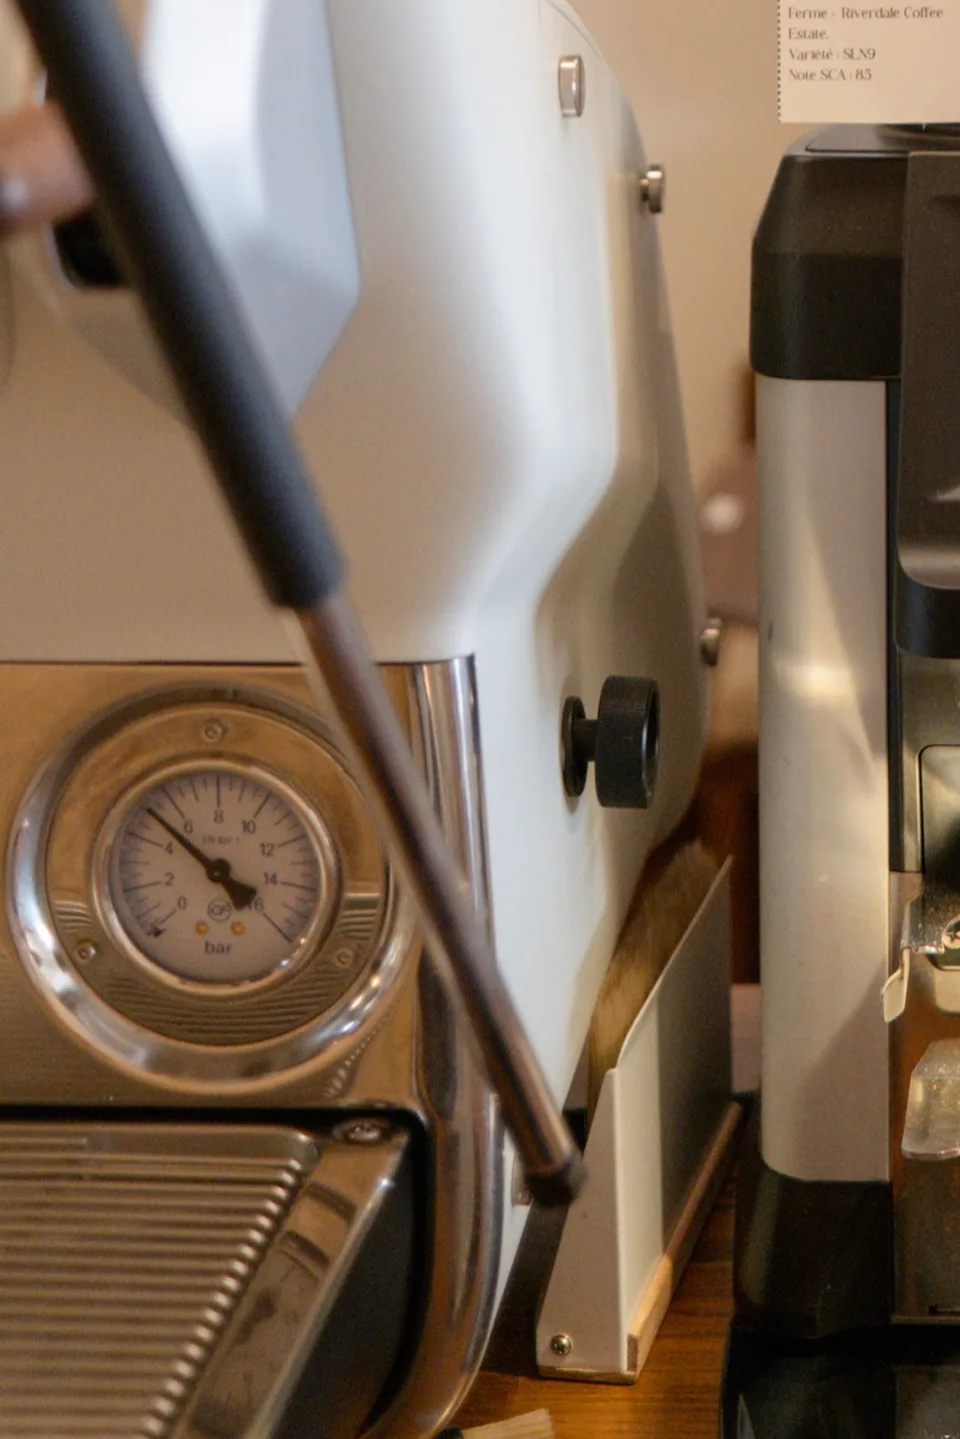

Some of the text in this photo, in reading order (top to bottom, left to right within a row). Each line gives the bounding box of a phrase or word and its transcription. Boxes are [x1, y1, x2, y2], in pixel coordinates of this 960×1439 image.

[788, 6, 828, 19] Ferme
[841, 6, 900, 19] Riverdale
[903, 6, 943, 19] Coffee
[788, 48, 833, 61] Variété
[842, 47, 877, 61] SLN9
[788, 68, 816, 80] Note
[819, 68, 847, 81] SCA
[854, 68, 872, 81] 85
[213, 810, 224, 824] 8
[183, 820, 194, 835] 6
[241, 819, 257, 834] 10
[164, 842, 175, 856] 4
[260, 842, 274, 857] 12
[164, 872, 175, 886] 2
[263, 871, 278, 886] 14
[177, 896, 187, 910] 0
[204, 940, 233, 955] bar
